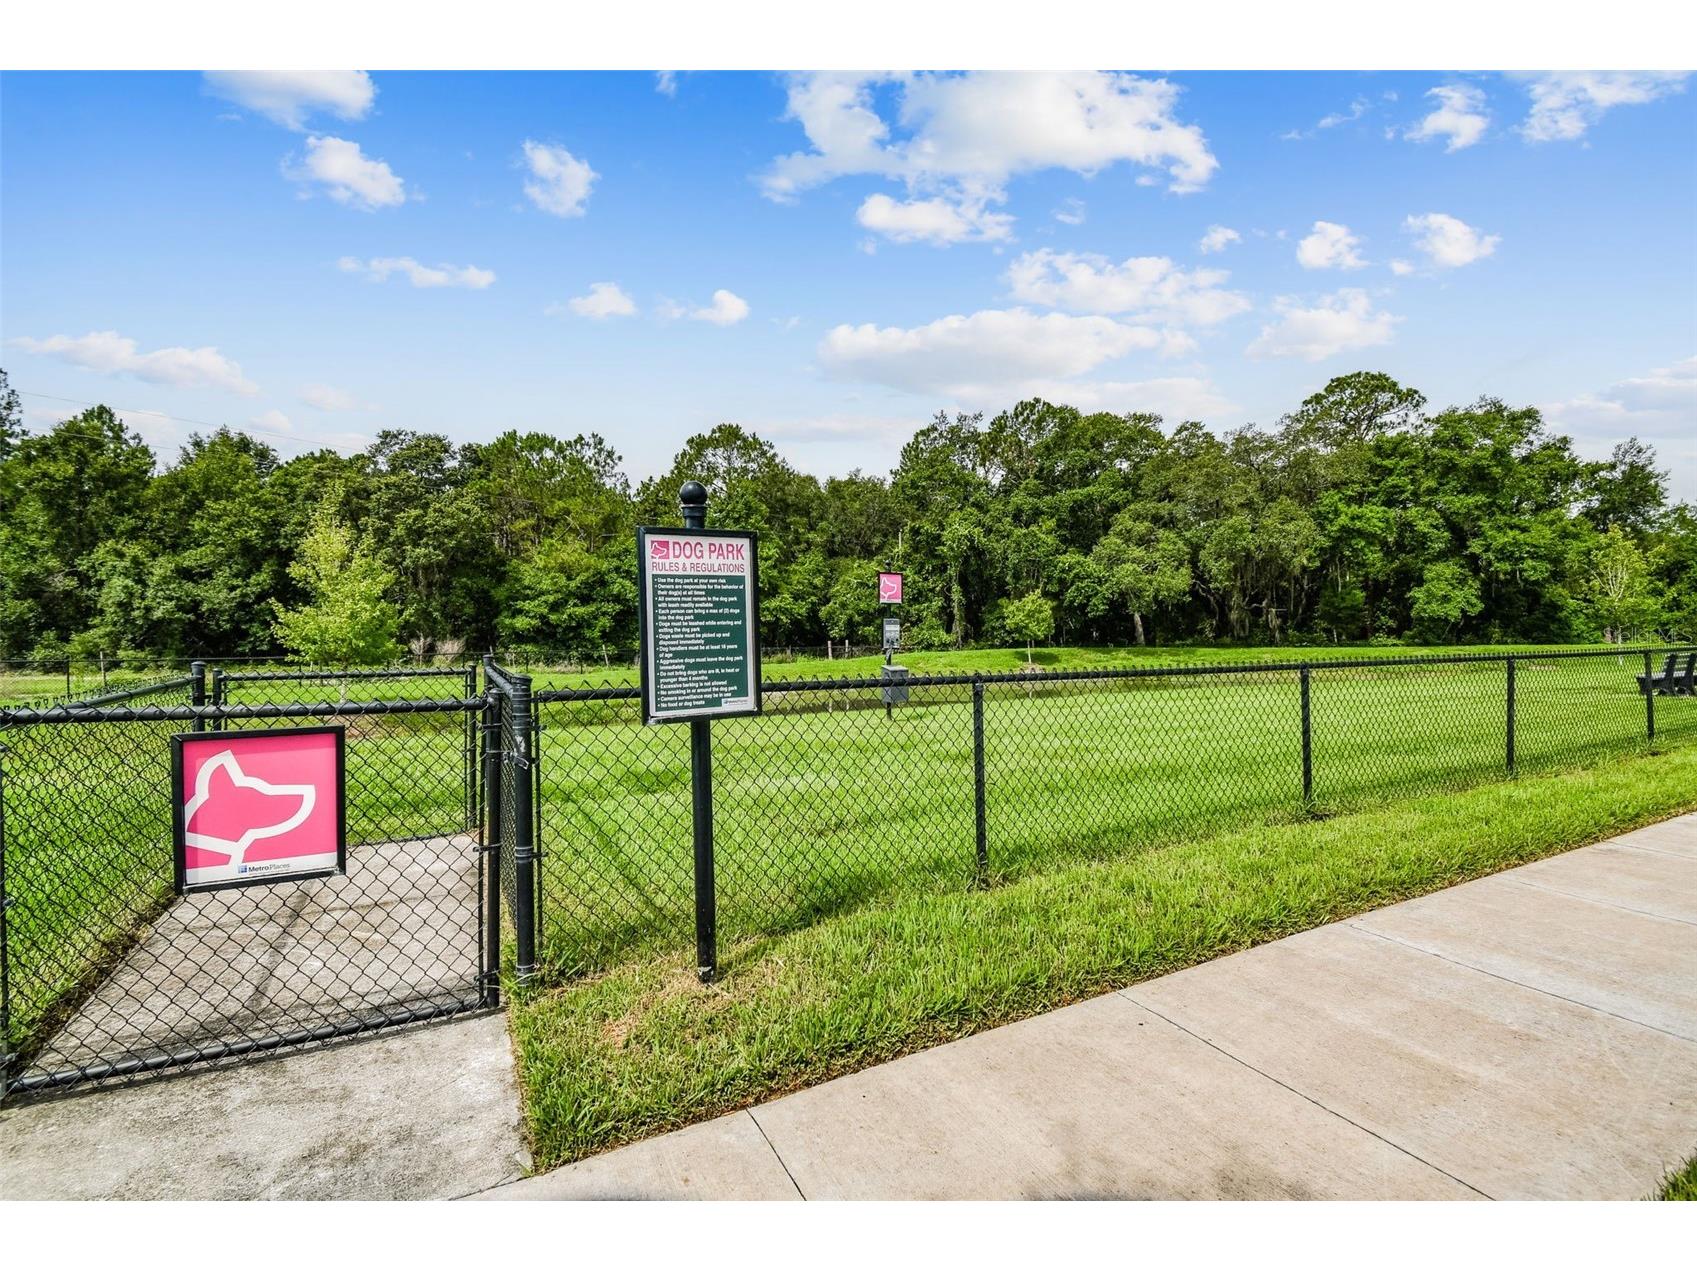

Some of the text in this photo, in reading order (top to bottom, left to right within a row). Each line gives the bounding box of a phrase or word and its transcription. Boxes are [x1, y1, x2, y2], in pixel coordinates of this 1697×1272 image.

[672, 541, 744, 560] DOG PARK
[652, 562, 744, 572] RULES & REGULATIONS
